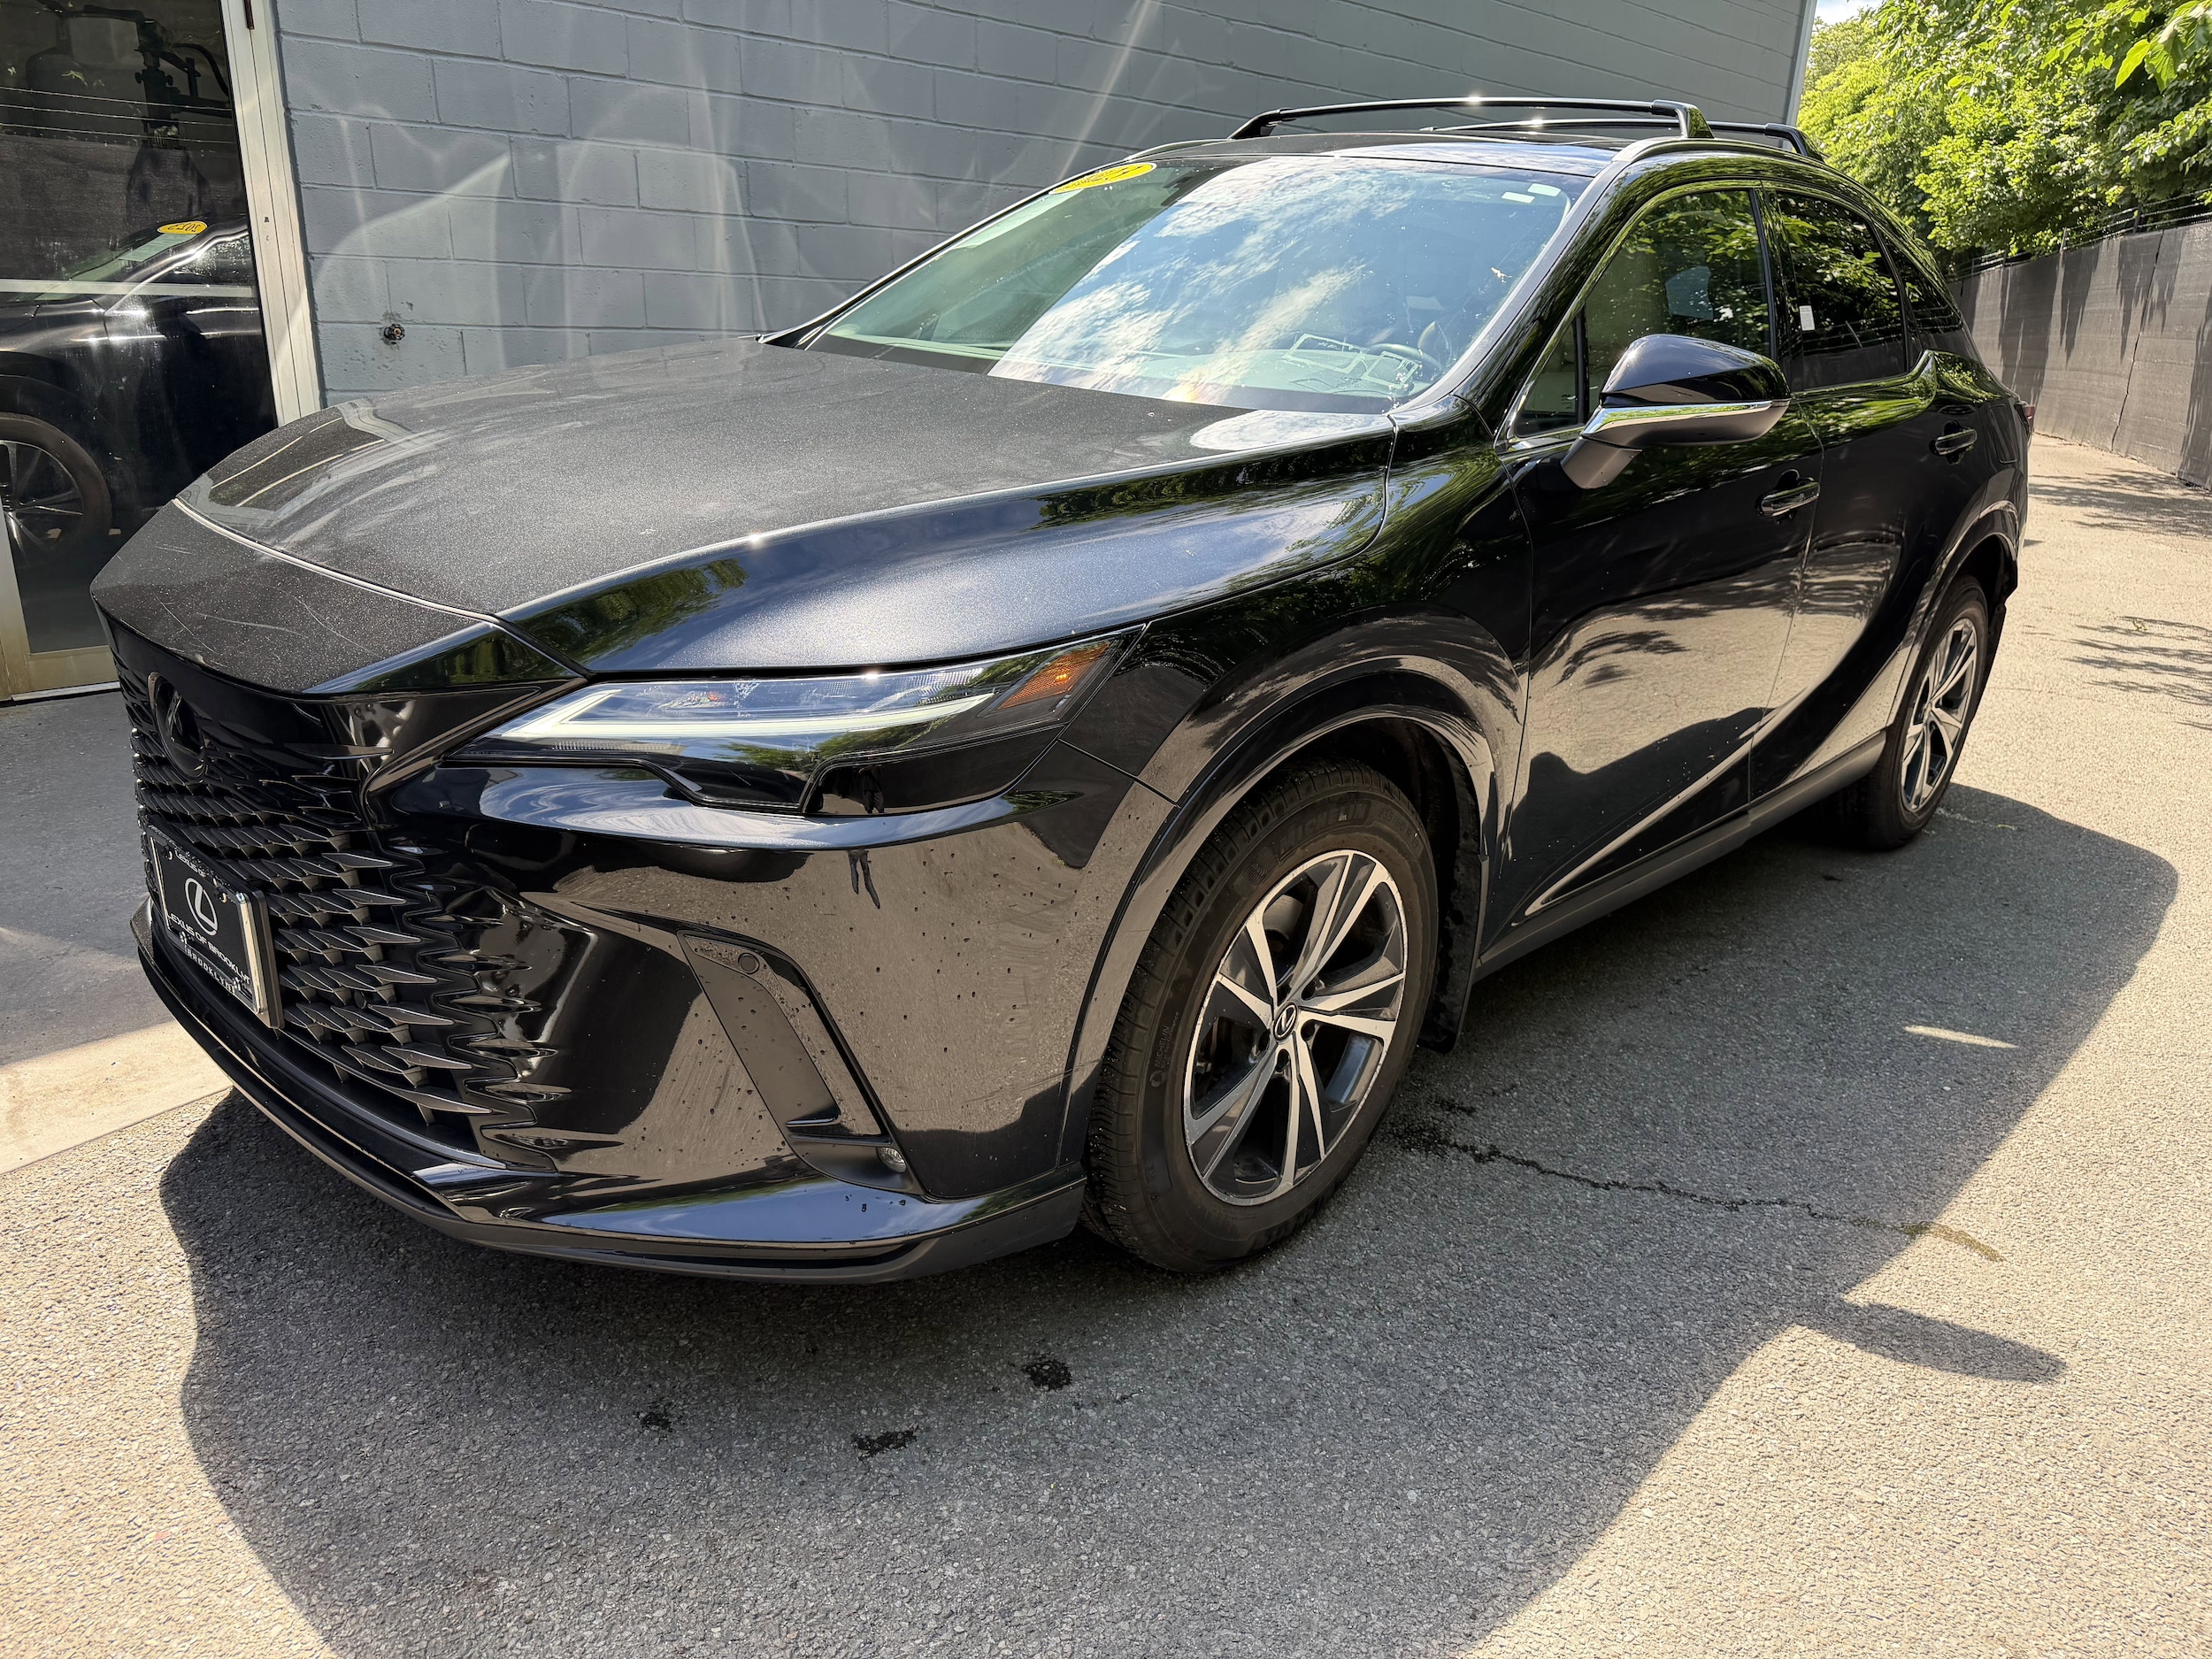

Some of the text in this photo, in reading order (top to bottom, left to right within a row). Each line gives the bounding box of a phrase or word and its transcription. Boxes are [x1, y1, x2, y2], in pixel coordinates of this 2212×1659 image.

[174, 848, 198, 873] LEXUS
[195, 931, 208, 944] OF
[1155, 1025, 1170, 1068] MICHELIN
